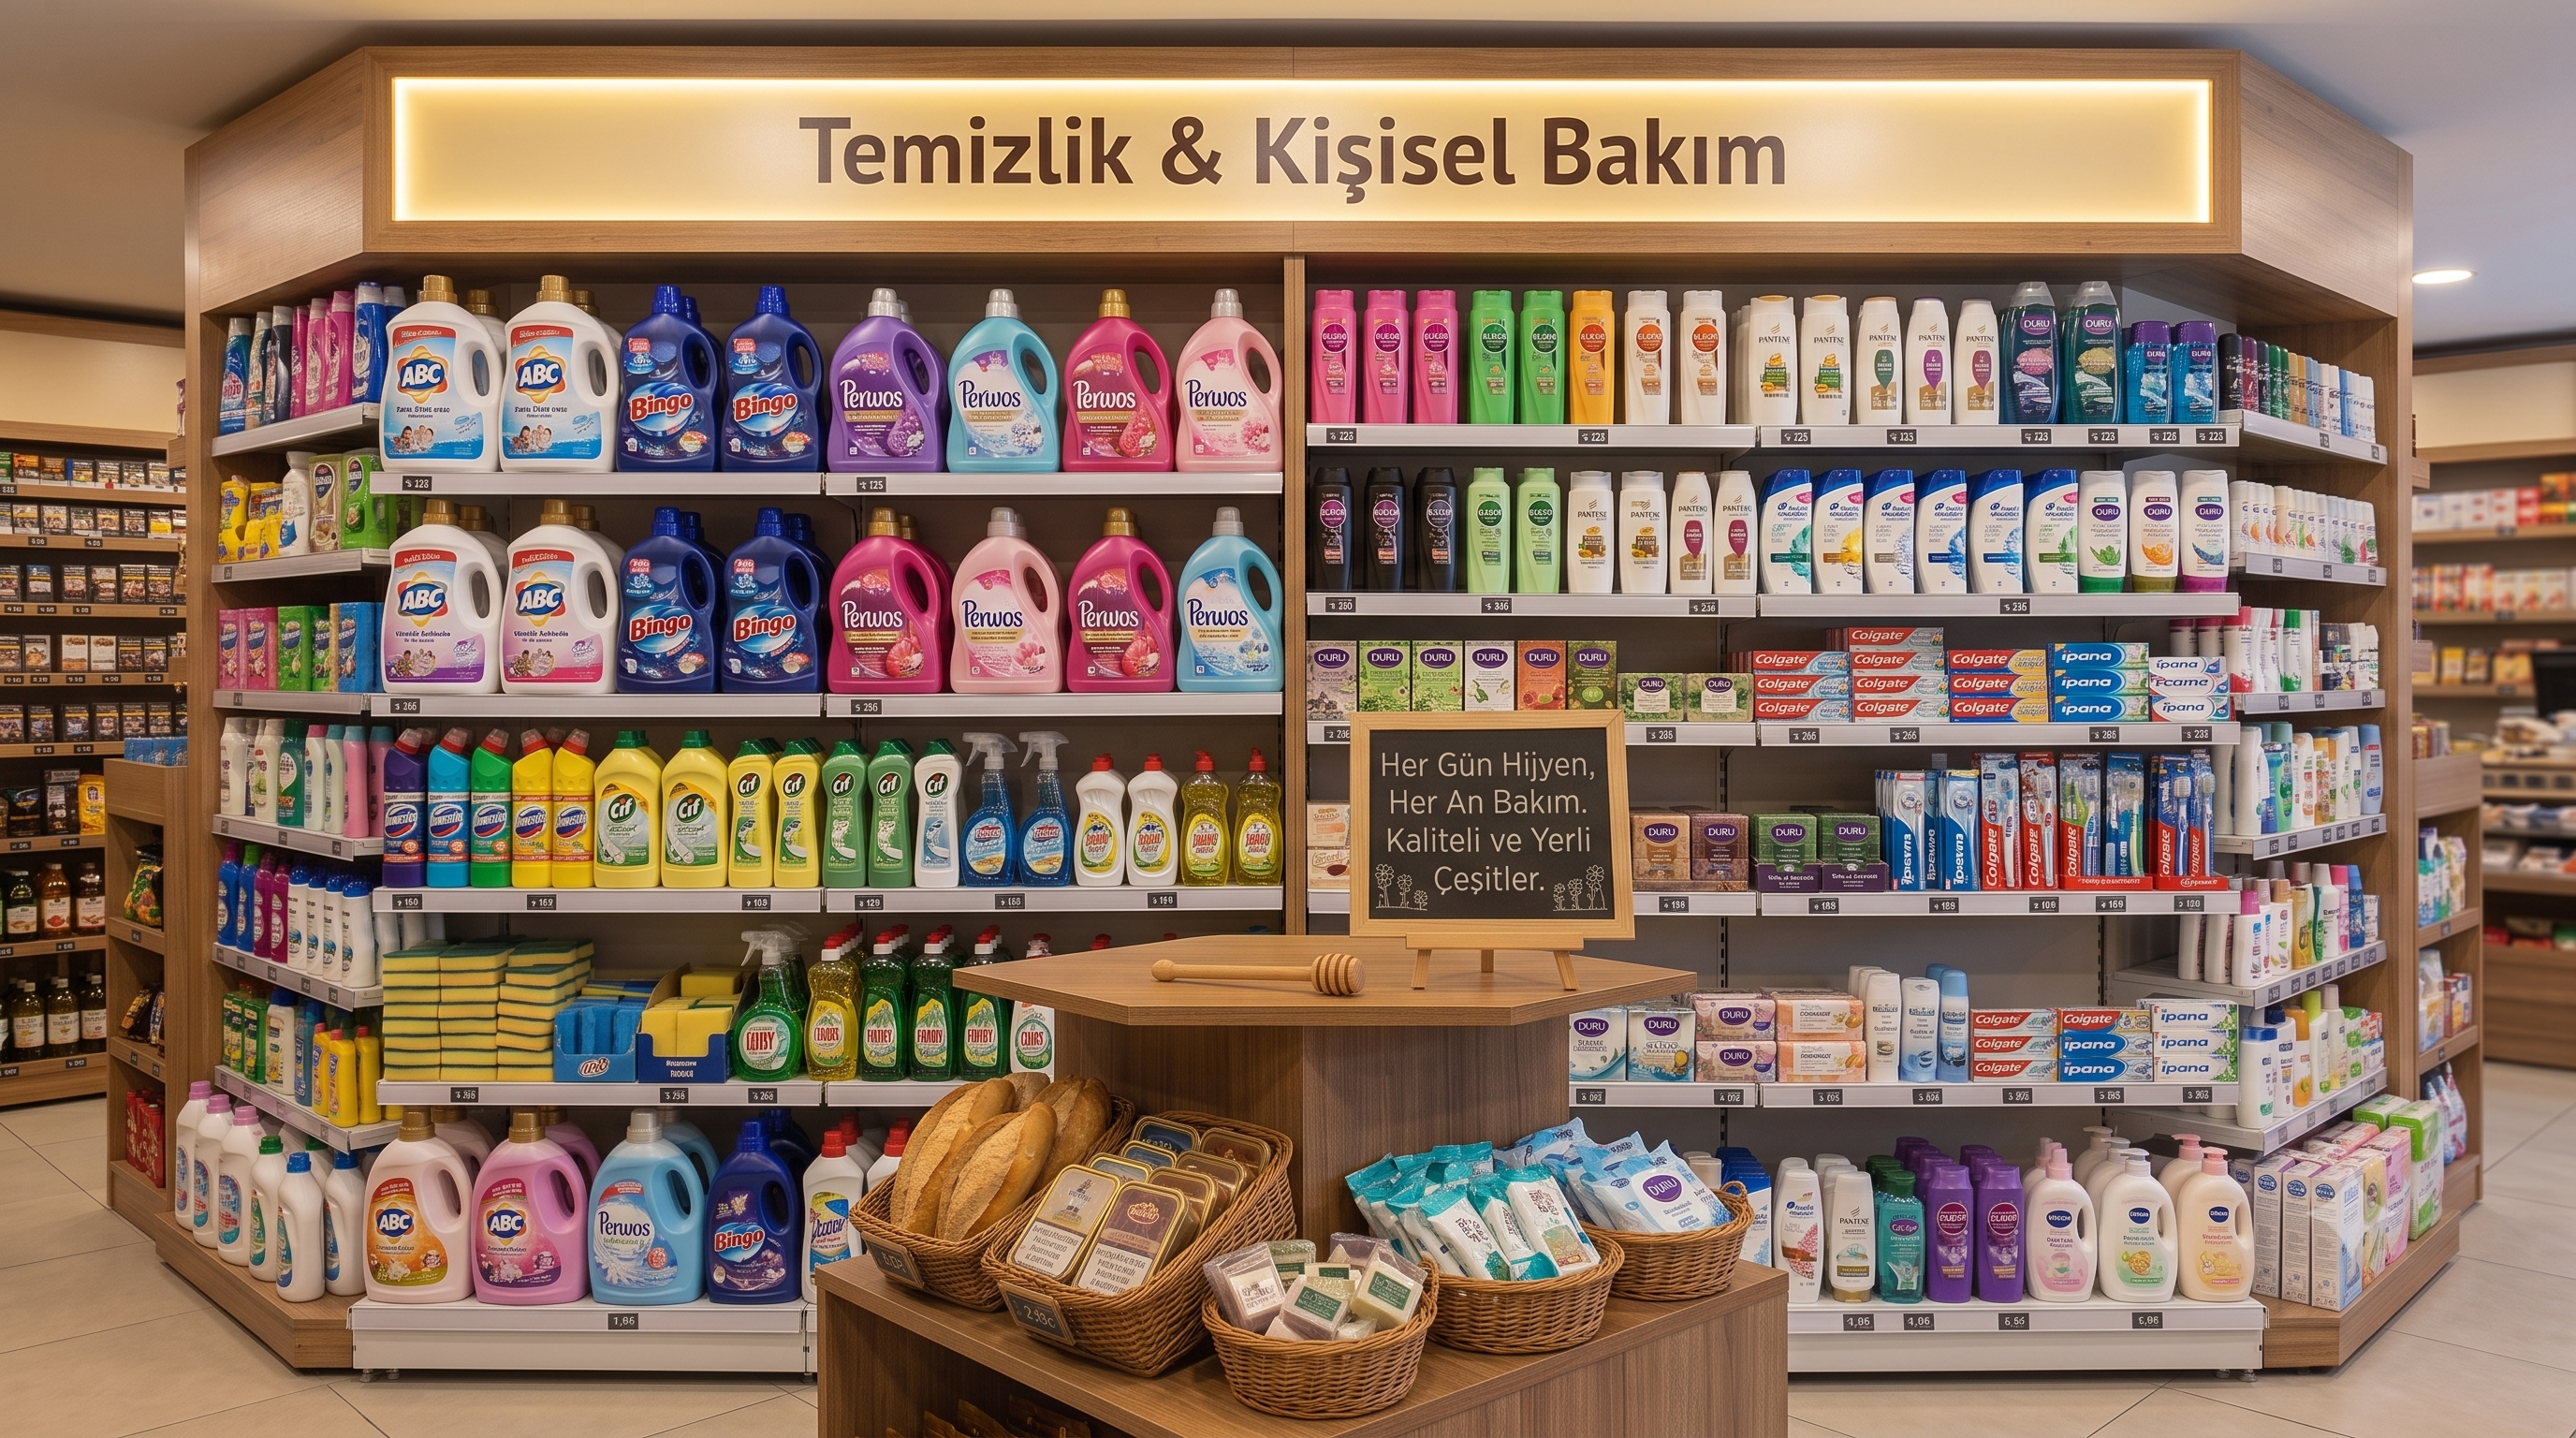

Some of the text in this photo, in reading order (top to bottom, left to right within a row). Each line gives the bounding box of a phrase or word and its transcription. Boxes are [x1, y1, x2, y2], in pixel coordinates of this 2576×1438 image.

[799, 116, 1785, 204] Temizlik & Kişisel Bakım
[402, 364, 441, 387] ABC
[520, 363, 559, 387] ABC
[841, 379, 902, 409] Perwos
[959, 379, 1021, 409] Perwos
[1073, 379, 1135, 409] Perwos
[1185, 379, 1247, 409] Perwos
[629, 391, 693, 420] Bingo
[734, 390, 798, 423] Bingo
[402, 588, 443, 610] ABC
[520, 588, 561, 610] ABC
[842, 600, 902, 629] Perwos
[962, 600, 1023, 629] Perwos
[1078, 600, 1139, 629] Perwos
[1186, 598, 1249, 628] Perwos
[629, 613, 692, 643] Bingo
[734, 613, 796, 643] Bingo
[1371, 653, 1399, 662] DURU
[1424, 653, 1452, 662] DURU
[1477, 653, 1504, 662] DURU
[1529, 653, 1557, 662] DURU
[1755, 654, 1808, 667] Colgate
[1854, 654, 1904, 667] Colgate
[1953, 653, 2007, 667] Colgate
[2061, 651, 2112, 663] ipana
[2157, 659, 2198, 670] ipana
[1757, 678, 1809, 690] Colgate
[1856, 679, 1909, 690] Colgate
[1954, 678, 2009, 691] Colgate
[2061, 676, 2112, 688] ipana
[1758, 701, 1810, 713] Colgate
[1857, 702, 1909, 714] Colgate
[1954, 702, 2010, 715] Colgate
[2061, 702, 2112, 715] ipana
[2162, 702, 2204, 712] ipana
[1382, 752, 1595, 782] Her Gün Hijyen,
[739, 774, 757, 793] Cif
[784, 775, 802, 794] Cif
[833, 775, 852, 793] Cif
[879, 775, 899, 793] Cif
[926, 775, 945, 793] Cif
[610, 798, 633, 818] Cif
[679, 798, 701, 818] Cif
[1390, 789, 1587, 814] Her An Bakım.
[1648, 828, 1676, 836] DURU
[1708, 828, 1735, 836] DURU
[1776, 828, 1802, 837] DURU
[1838, 827, 1866, 835] DURU
[1387, 827, 1590, 852] Kaliteli ve Yerli
[1435, 866, 1544, 895] Çeşitler.
[1976, 1014, 2022, 1026] Colgate
[2063, 1014, 2113, 1026] Colgate
[2159, 1011, 2208, 1023] ipana
[1578, 1021, 1606, 1031] DURU
[1648, 1020, 1676, 1030] DURU
[1975, 1038, 2022, 1049] Colgate
[2064, 1039, 2115, 1051] ipana
[2160, 1037, 2209, 1049] ipana
[1975, 1063, 2022, 1074] Colgate
[2064, 1064, 2115, 1076] ipana
[2160, 1063, 2209, 1074] ipana
[379, 1214, 412, 1230] ABC
[490, 1215, 523, 1232] ABC
[598, 1211, 651, 1236] Perwos
[715, 1228, 765, 1252] Bingo
